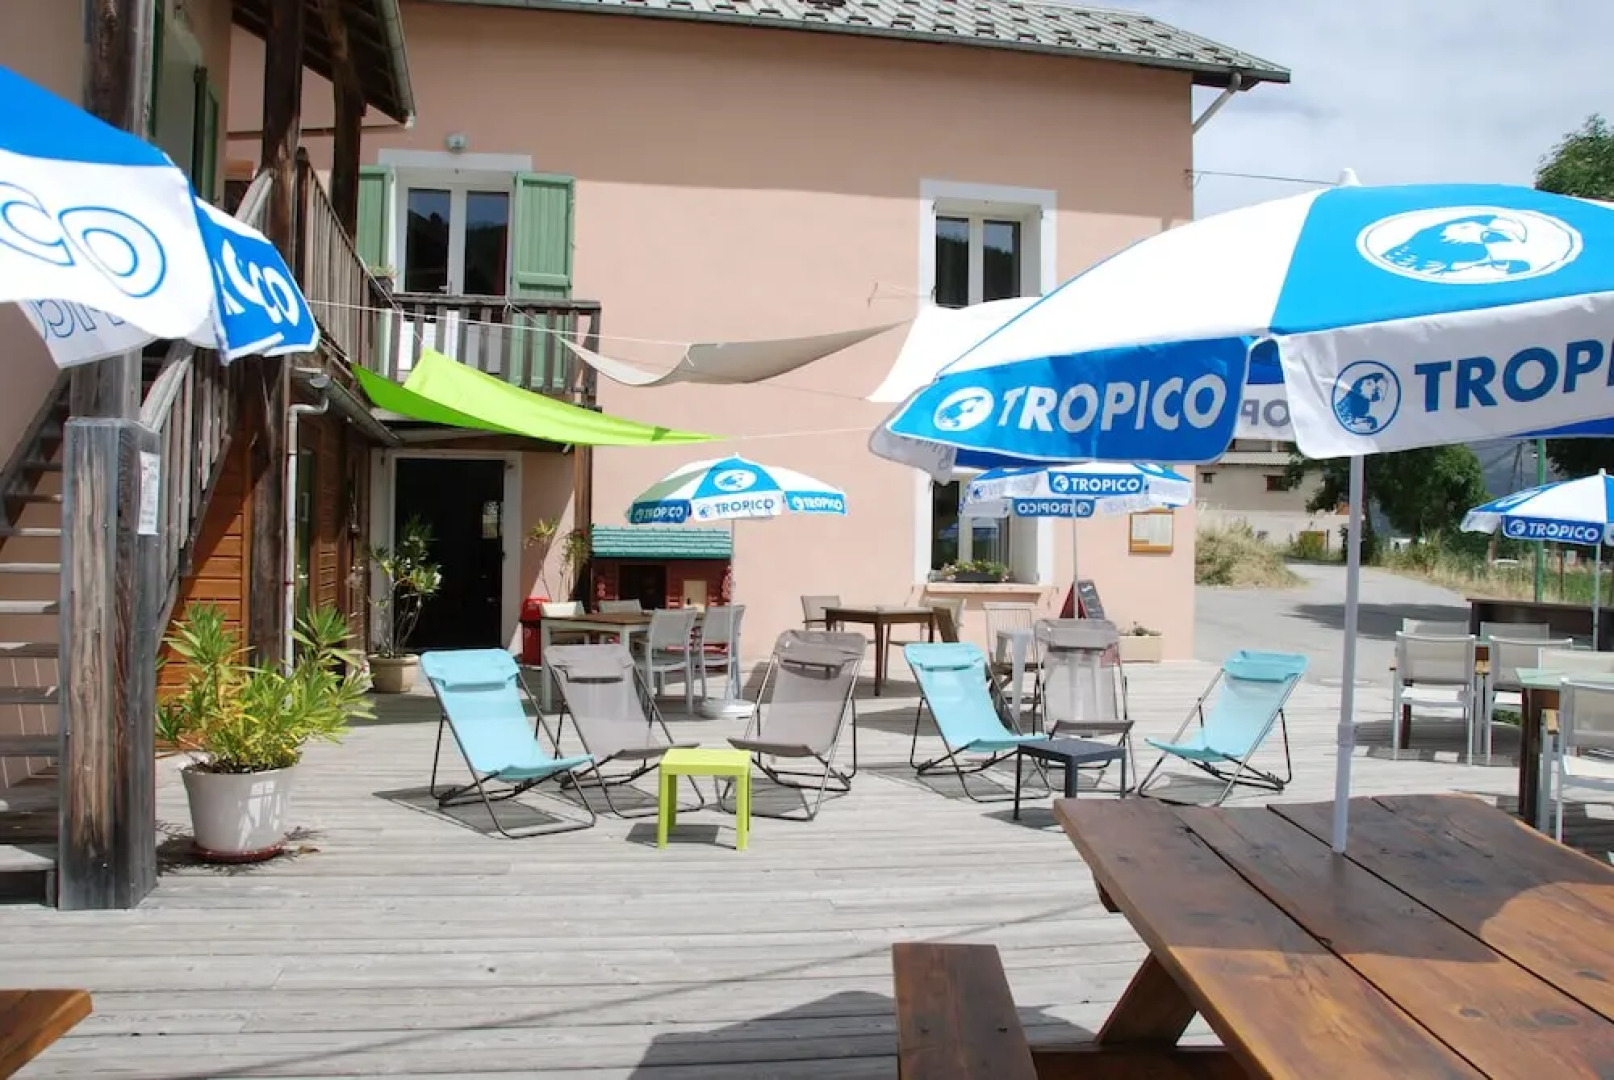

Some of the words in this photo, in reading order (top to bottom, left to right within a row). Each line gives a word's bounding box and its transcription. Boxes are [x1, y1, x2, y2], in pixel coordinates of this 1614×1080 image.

[997, 374, 1228, 433] TROPICO
[1070, 477, 1141, 492] TROPICO
[714, 498, 774, 514] TROPICO
[1528, 522, 1599, 540] TROPICO
